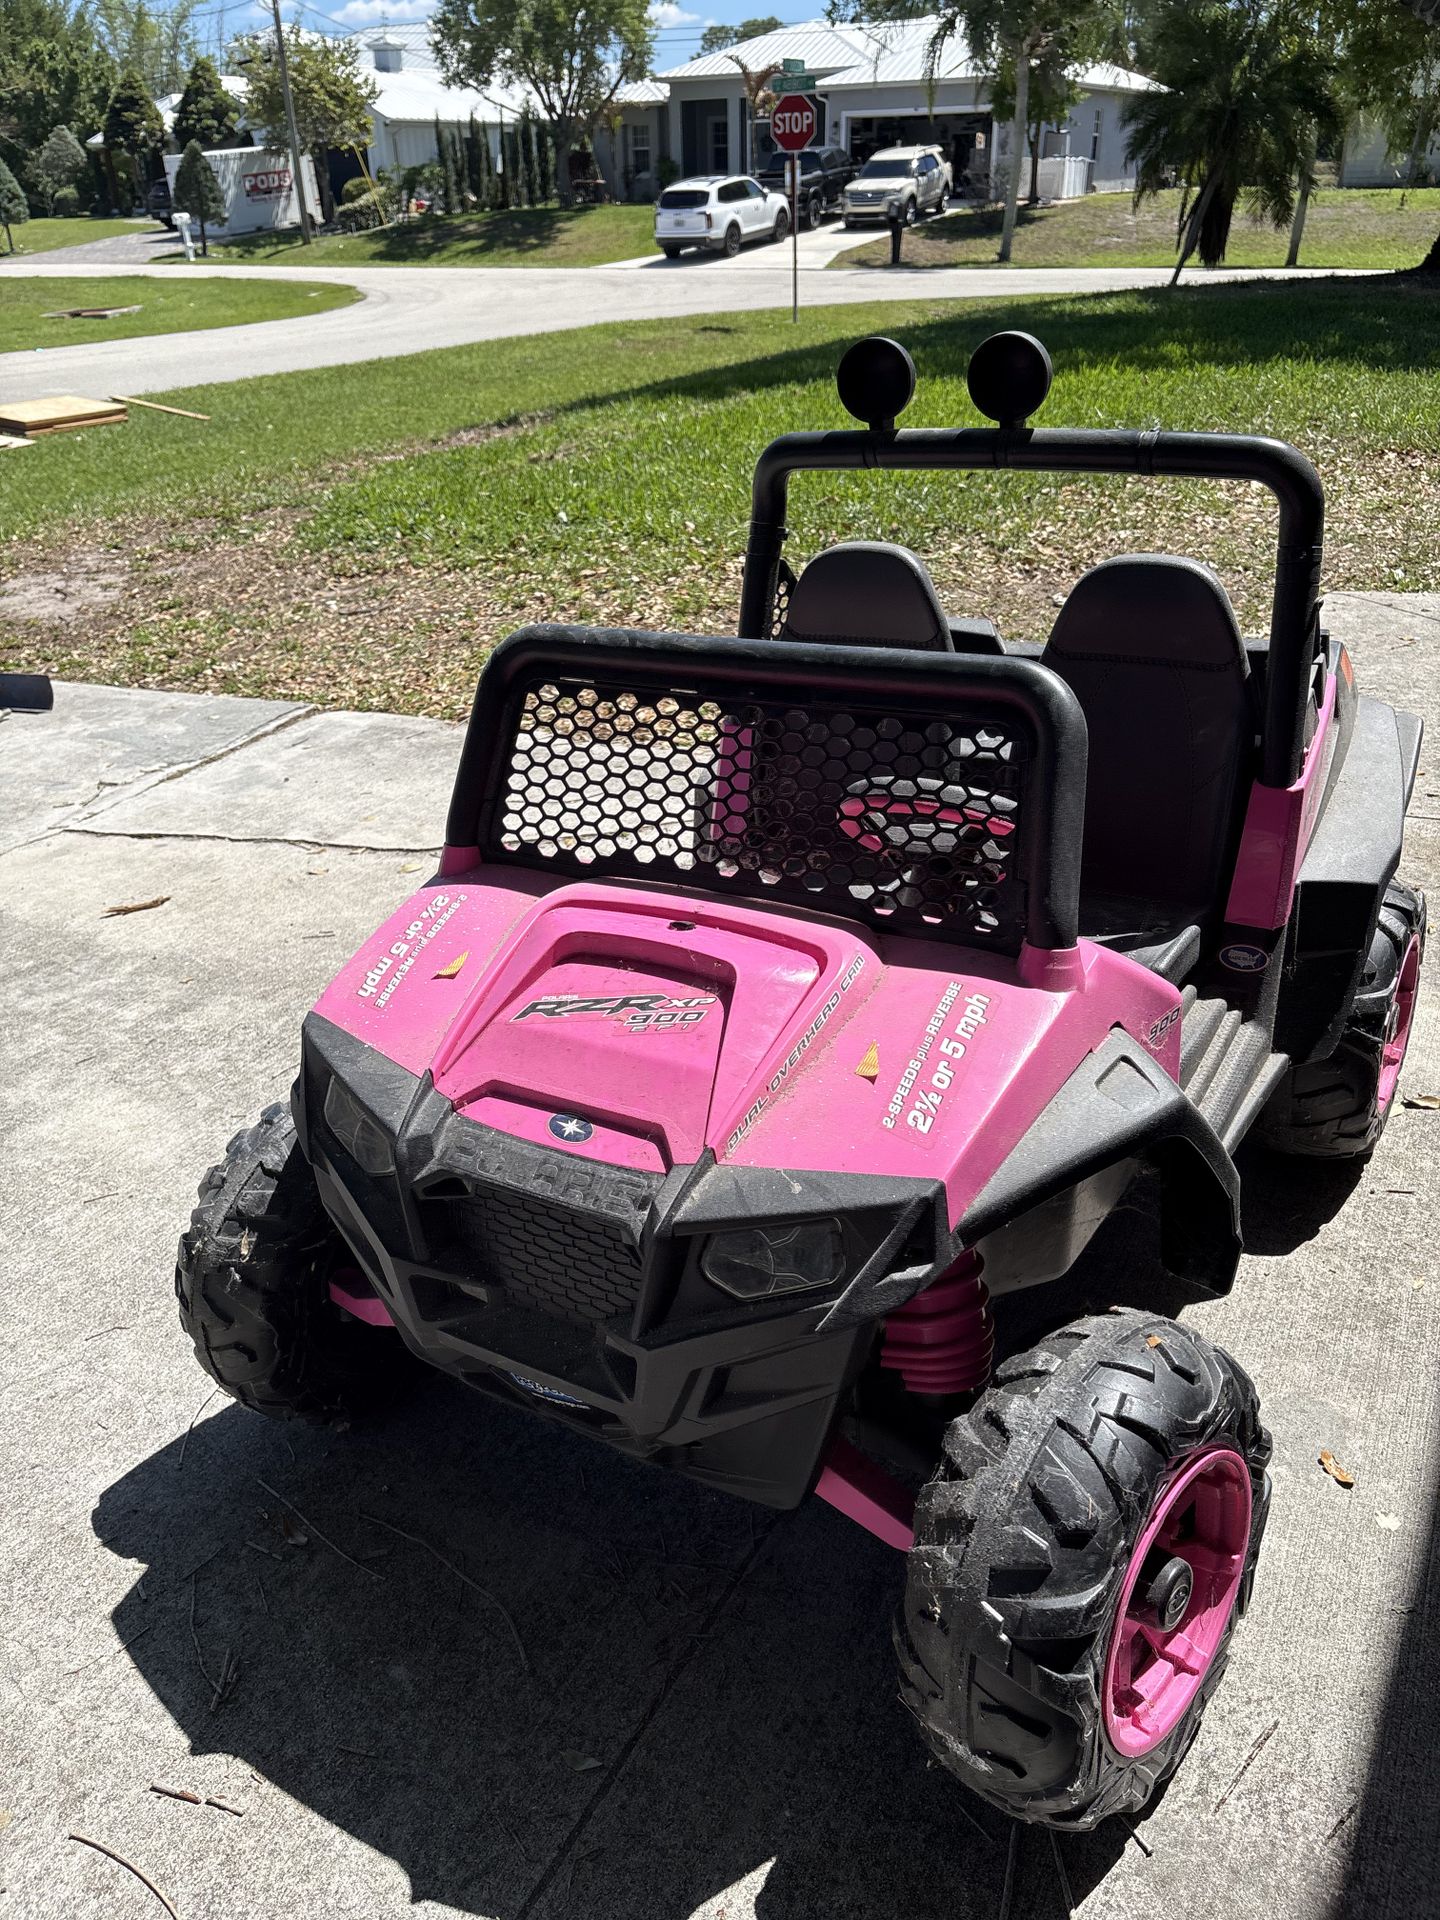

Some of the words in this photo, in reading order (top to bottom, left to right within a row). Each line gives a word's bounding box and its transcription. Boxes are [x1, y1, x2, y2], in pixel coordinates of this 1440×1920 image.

[774, 111, 813, 134] STOP
[245, 171, 291, 190] PODS
[404, 920, 424, 940] or
[426, 894, 468, 939] 2-SPEEDS
[389, 941, 410, 958] 5
[412, 937, 428, 957] plus
[357, 956, 394, 998] mph
[374, 957, 415, 1008] REVERSE
[509, 993, 670, 1022] RZR
[662, 997, 717, 1009] XP
[541, 994, 579, 1002] POLARIS
[624, 1010, 708, 1026] 900
[955, 992, 992, 1041] mph
[1148, 1005, 1181, 1042] 900
[726, 1095, 769, 1151] DUAL
[768, 991, 841, 1093] OVERHEAD
[840, 954, 866, 992] CAM
[882, 1059, 923, 1130] 2-SPEEDS
[915, 1034, 935, 1061] plus
[925, 981, 963, 1038] REVERSE
[939, 1037, 966, 1060] 5
[931, 1061, 956, 1090] or
[454, 1135, 648, 1217] POLARIS
